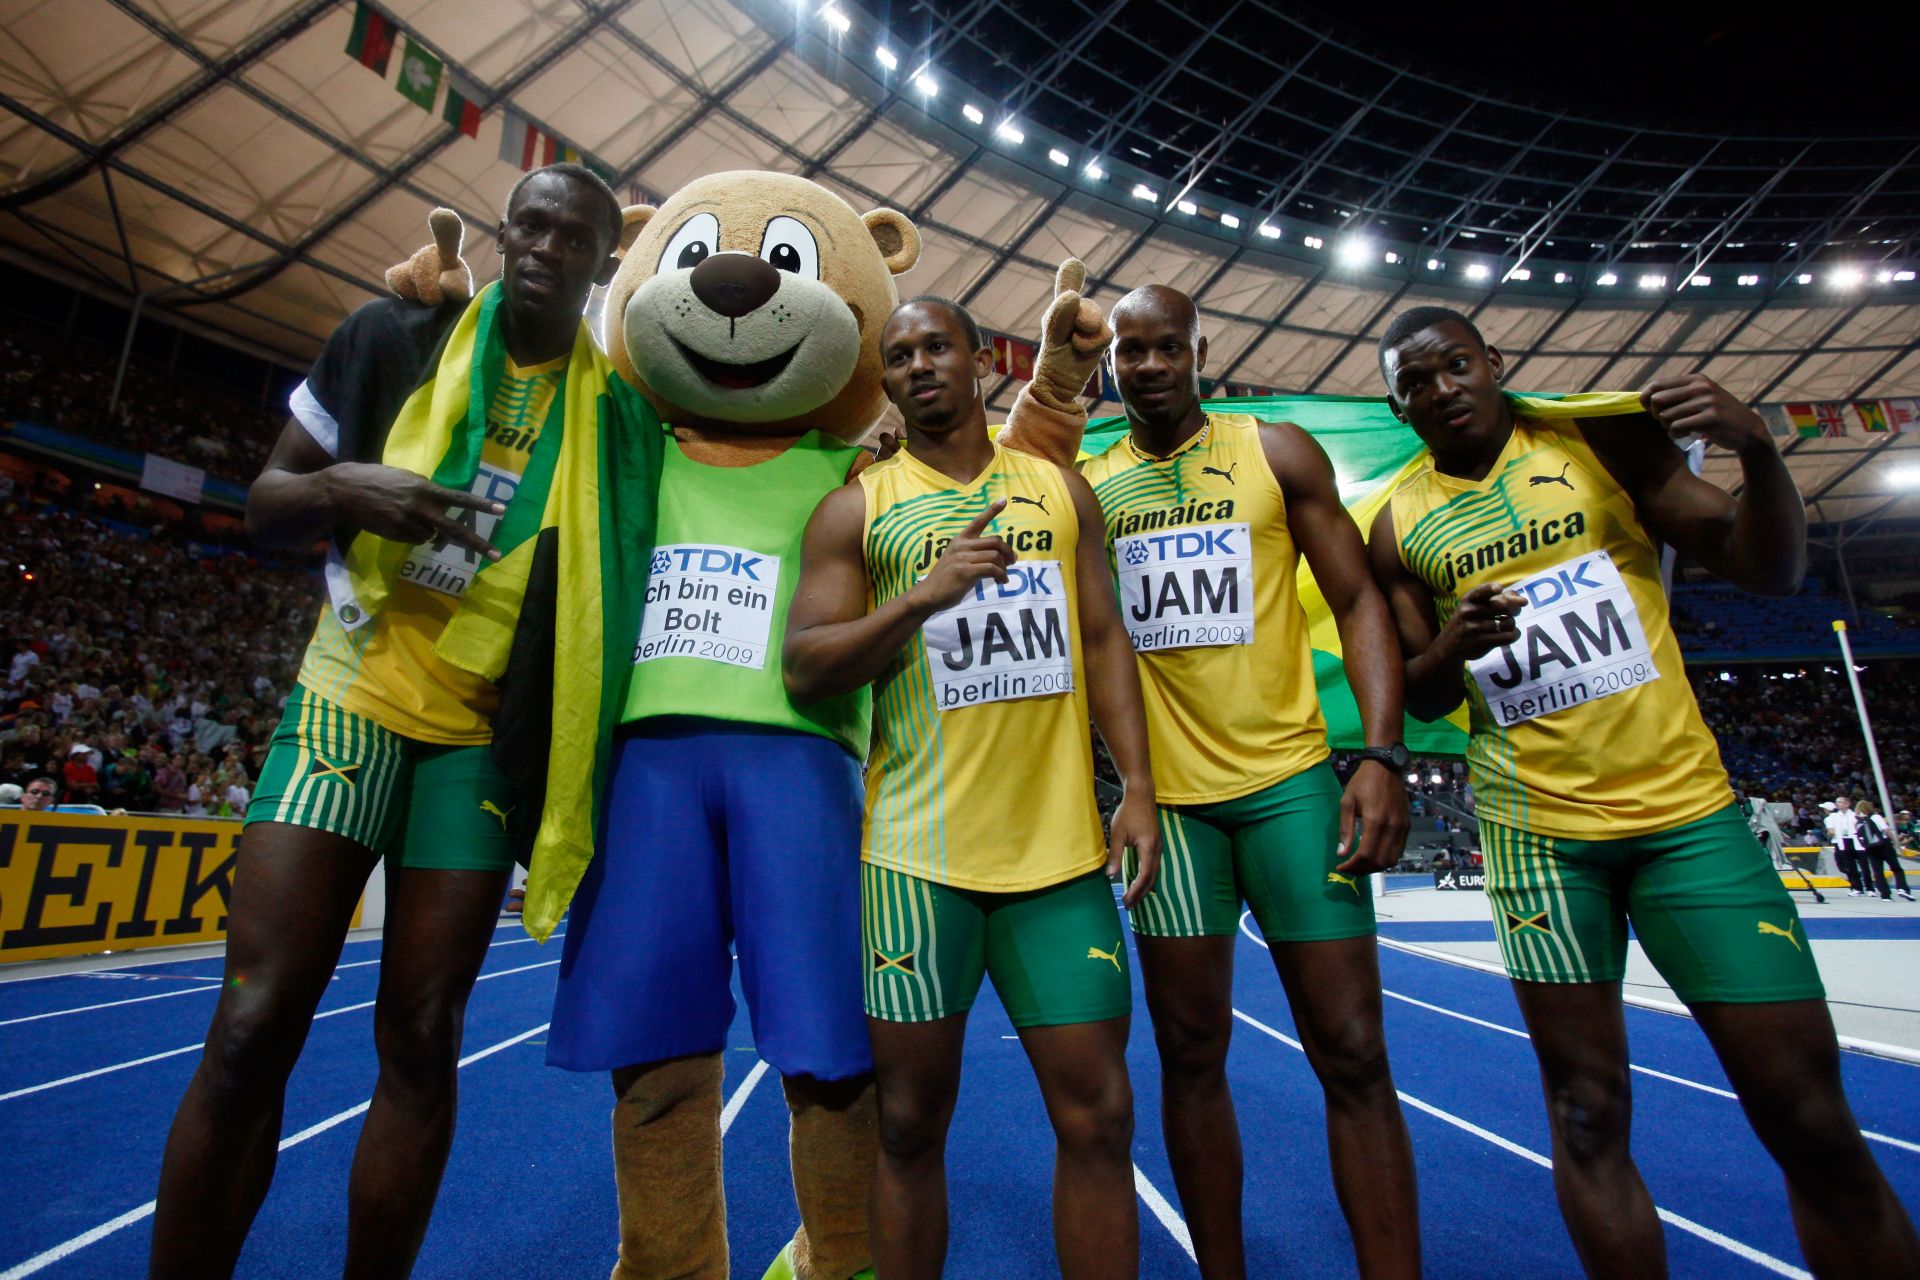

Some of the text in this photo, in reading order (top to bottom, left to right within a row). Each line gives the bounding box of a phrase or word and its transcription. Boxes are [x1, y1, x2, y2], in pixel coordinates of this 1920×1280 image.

[1111, 498, 1234, 545] jamaica
[673, 548, 763, 581] TDK
[916, 526, 1053, 571] jaica
[1148, 528, 1236, 561] TDK
[1444, 511, 1585, 592] jamaica
[399, 560, 467, 594] erlin
[645, 578, 767, 611] ch bin ein
[1131, 567, 1239, 622] JAM
[1517, 560, 1604, 609] DK
[664, 607, 722, 635] Bolt
[942, 607, 1066, 672] JAM
[1131, 625, 1244, 649] berlin 2009
[700, 640, 753, 664] 2009
[1489, 598, 1633, 690] JAM
[944, 672, 1070, 706] berlin 2009
[1500, 662, 1647, 723] berlin 2009
[0, 824, 243, 950] EIK
